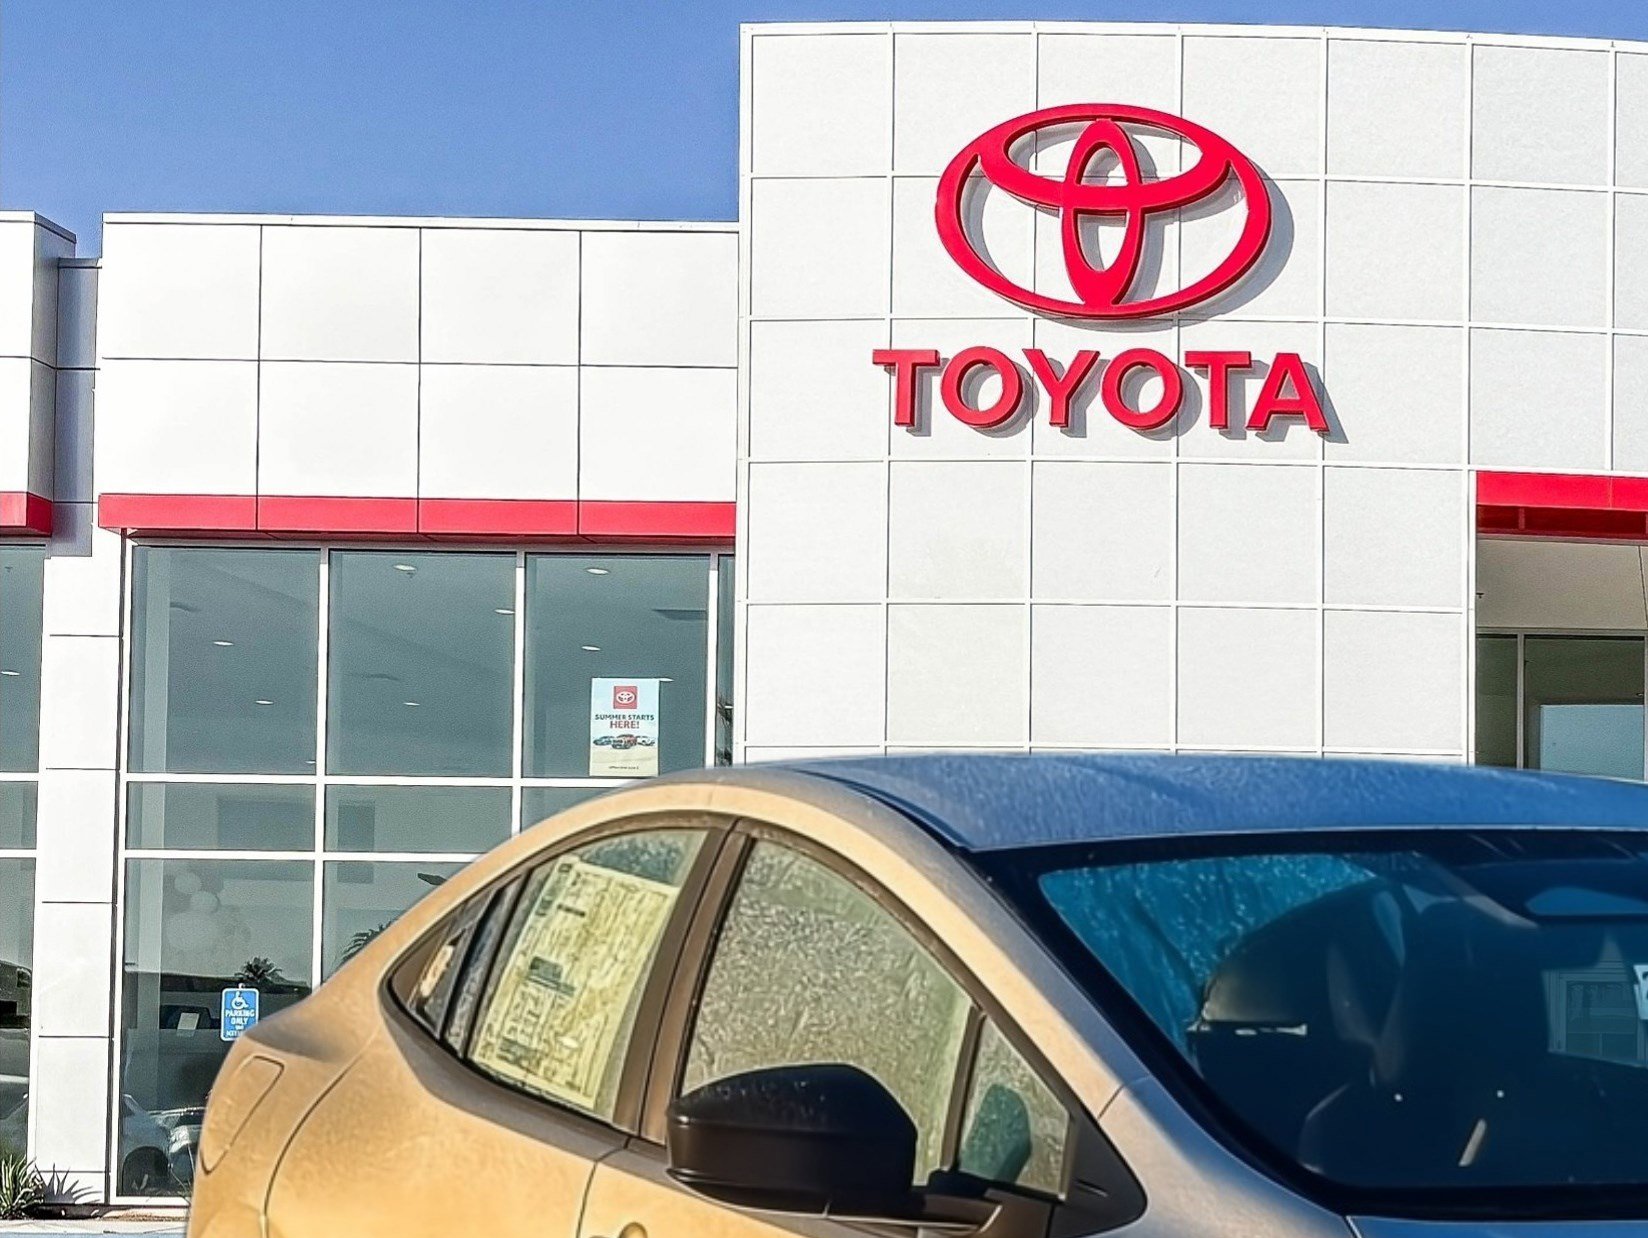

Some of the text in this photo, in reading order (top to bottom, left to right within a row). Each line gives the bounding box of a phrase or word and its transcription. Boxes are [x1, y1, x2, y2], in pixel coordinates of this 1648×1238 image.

[872, 346, 1330, 436] TOYOTA
[594, 713, 655, 721] SUMMER STARTS
[609, 720, 640, 729] HERE!
[225, 1009, 255, 1018] PARKING
[230, 1017, 249, 1025] ONLY
